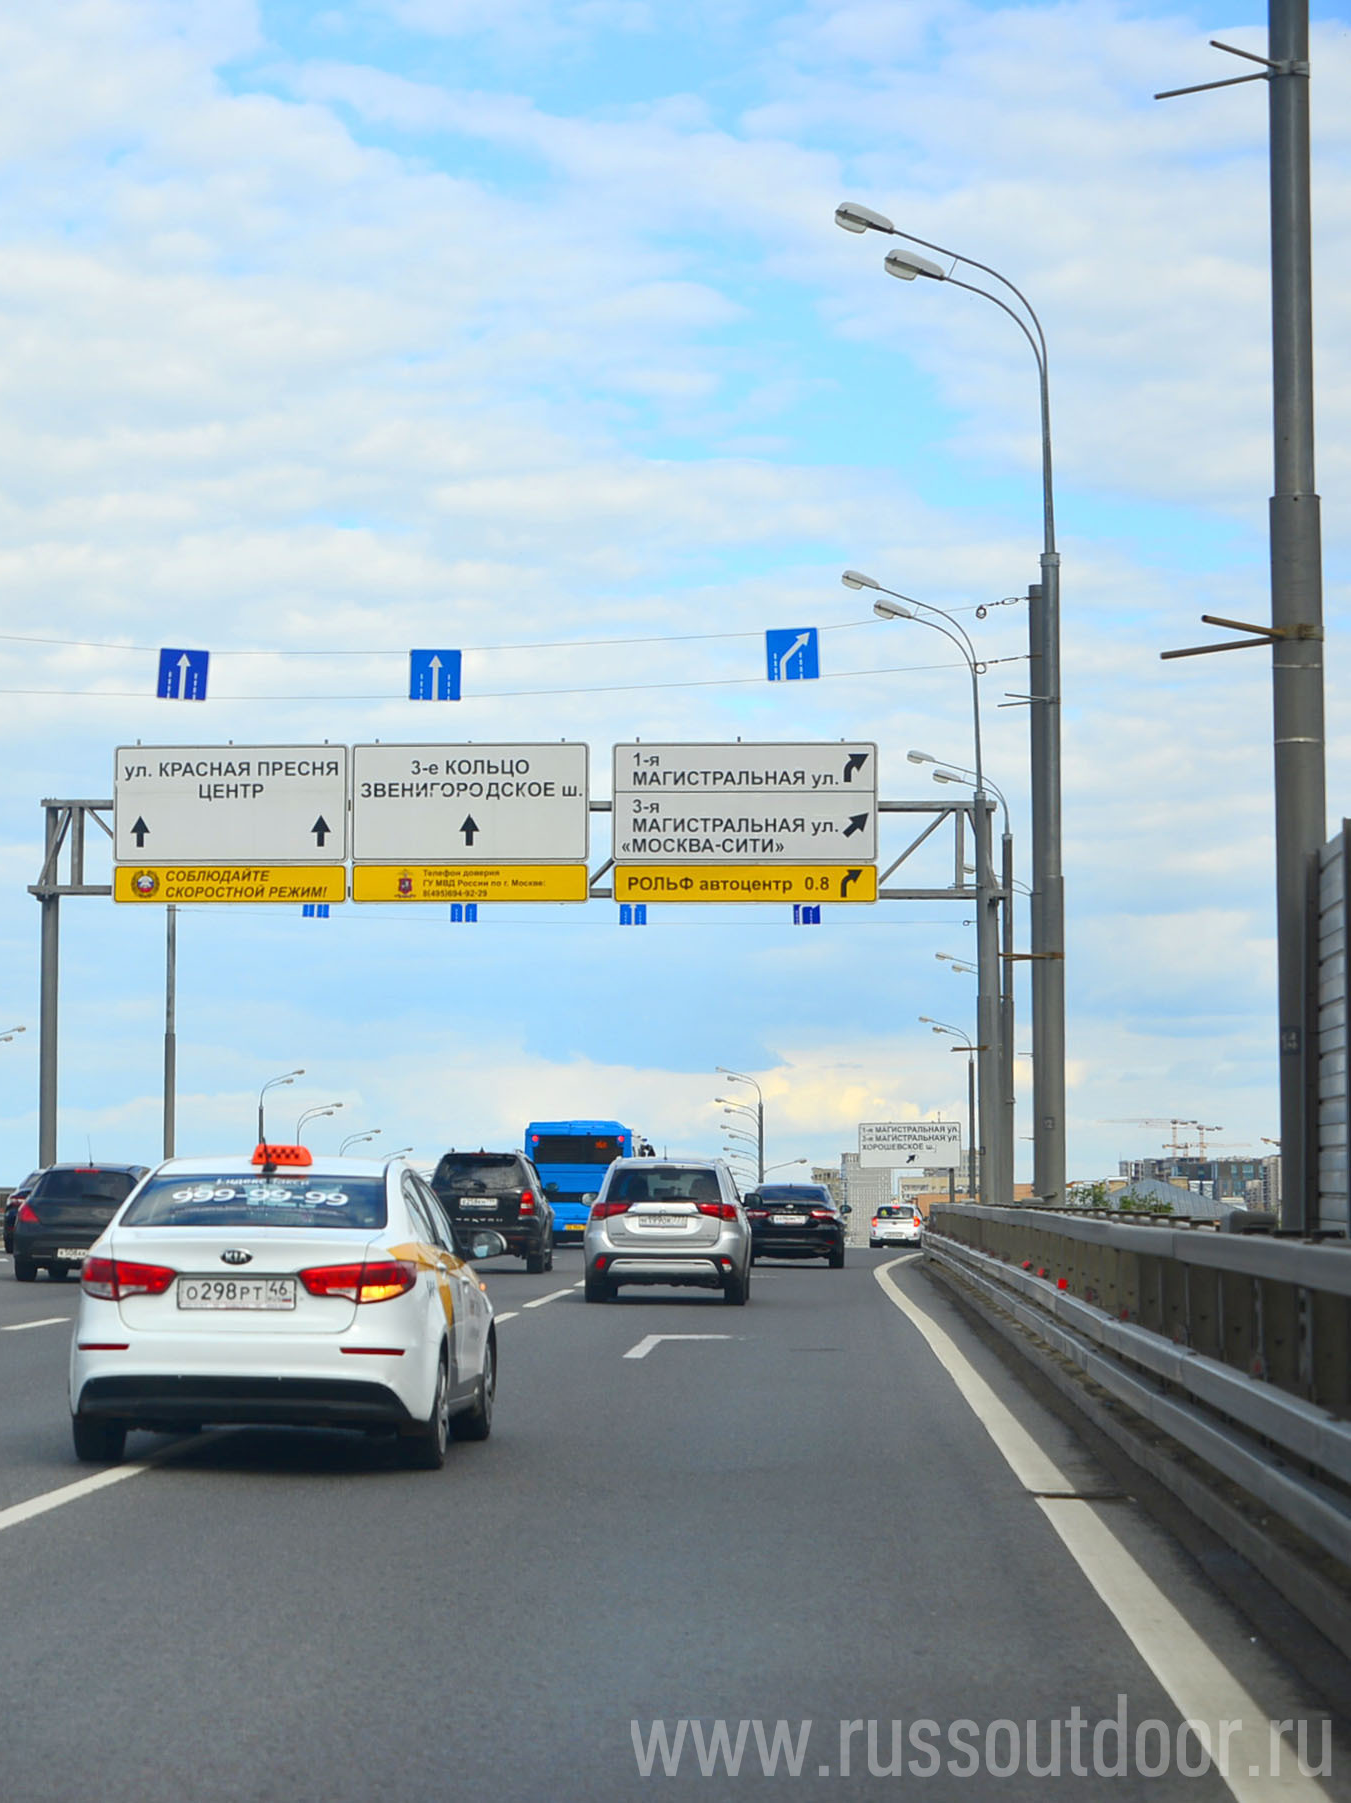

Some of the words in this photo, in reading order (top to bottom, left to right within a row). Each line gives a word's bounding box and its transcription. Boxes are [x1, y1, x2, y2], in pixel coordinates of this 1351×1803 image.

[633, 752, 660, 767] 1-я
[124, 765, 152, 781] ул.
[159, 761, 251, 777] КРАСНАЯ
[257, 761, 339, 777] ПРЕСНЯ
[411, 759, 439, 776] 3-е
[445, 759, 530, 778] КОЛЬЦО
[633, 770, 805, 786] МАГИСТРАЛЬНАЯ
[811, 774, 839, 789] ул.
[198, 783, 264, 802] ЦЕНТР
[361, 781, 555, 801] ЗВЕНИГОРОДСКОЕ
[562, 785, 584, 797] ш.
[633, 798, 660, 814] 3-я
[632, 817, 805, 833] МАГИСТРАЛЬНАЯ
[811, 821, 839, 837] ул.
[621, 838, 785, 853] «МОСКВА-СИТИ»
[165, 869, 270, 884] СОБЛЮДАЙТЕ
[627, 876, 694, 891] РОЛЬФ
[700, 879, 793, 894] автоцентр
[804, 876, 830, 891] 0.8
[164, 883, 264, 900] СКОРОСТНОЙ
[268, 884, 327, 899] РЕЖИМ!
[875, 1126, 946, 1134] МАГИСТРАЛЬНАЯ
[875, 1134, 946, 1142] МАГИСТРАЛЬНАЯ
[172, 1188, 349, 1206] 999-99-99
[225, 1251, 248, 1263] KIA
[269, 1280, 288, 1296] 46
